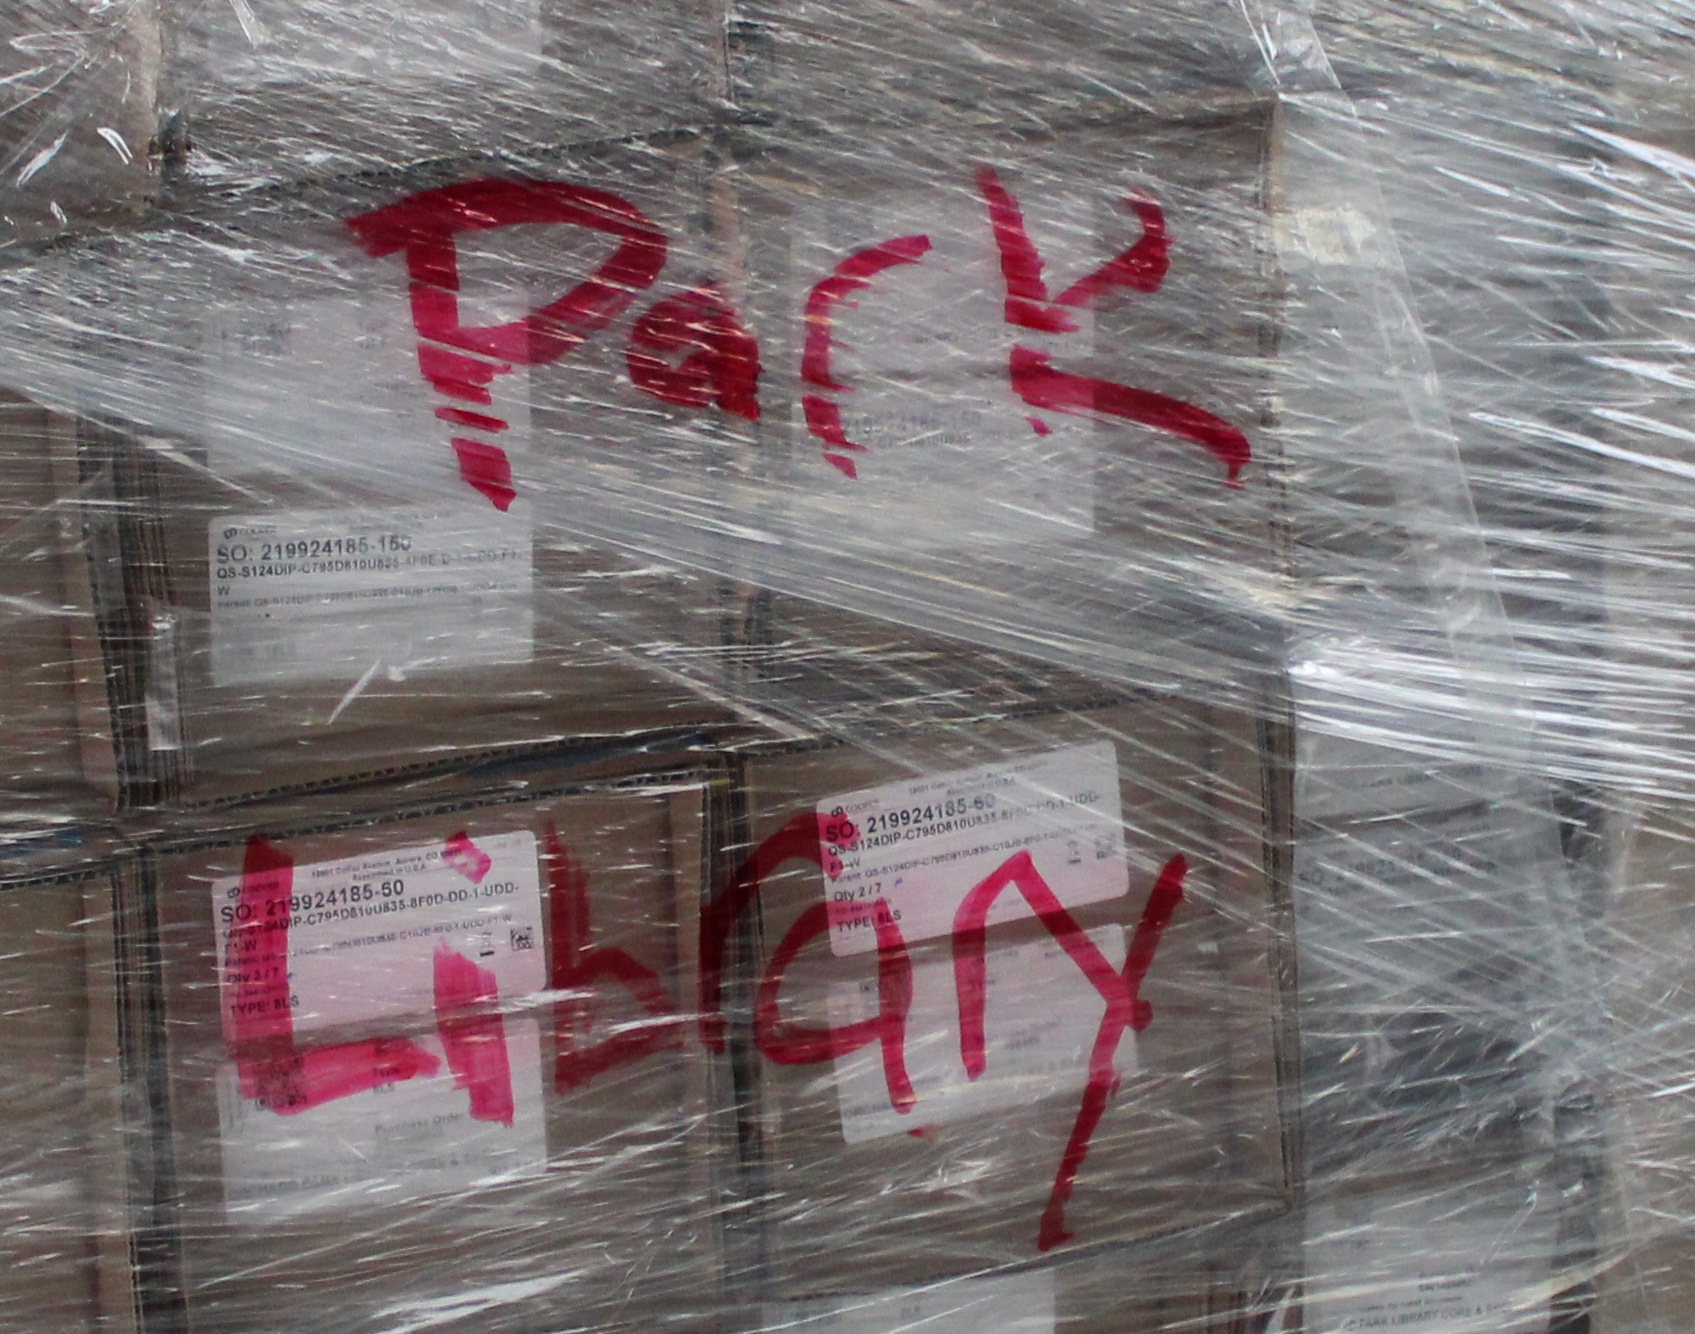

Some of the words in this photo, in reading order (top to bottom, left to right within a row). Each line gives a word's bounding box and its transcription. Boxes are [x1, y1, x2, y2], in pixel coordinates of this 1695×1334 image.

[216, 543, 253, 563] SO:
[826, 820, 861, 843] SO:
[867, 793, 995, 834] 219924185-60
[834, 890, 855, 903] Qty
[221, 903, 258, 923] SO:
